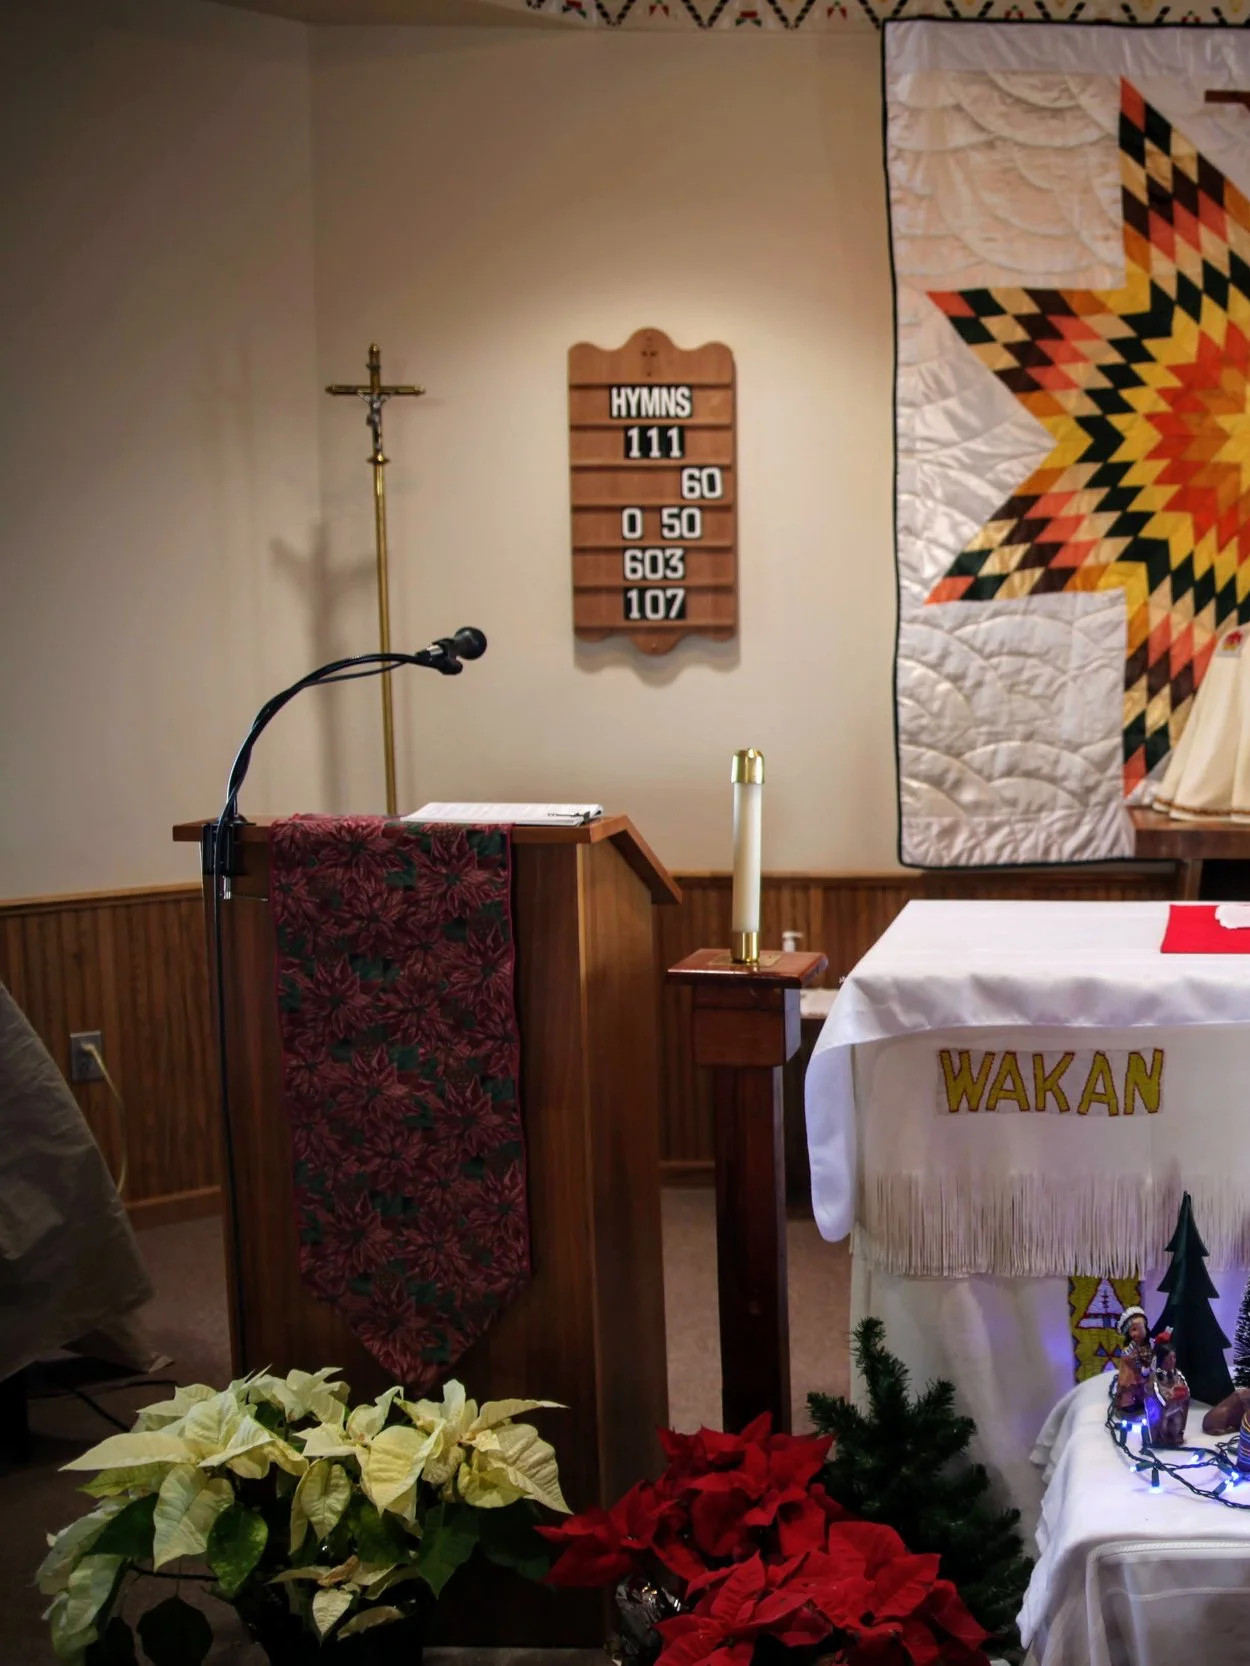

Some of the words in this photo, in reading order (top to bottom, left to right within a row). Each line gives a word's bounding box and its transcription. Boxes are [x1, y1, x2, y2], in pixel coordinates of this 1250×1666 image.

[610, 387, 691, 418] HYMNS
[627, 427, 683, 458] 111
[681, 467, 722, 499] 60
[661, 507, 702, 539] 50
[624, 548, 684, 580] 603
[626, 589, 685, 619] 107
[939, 1048, 1164, 1116] WAKAN
